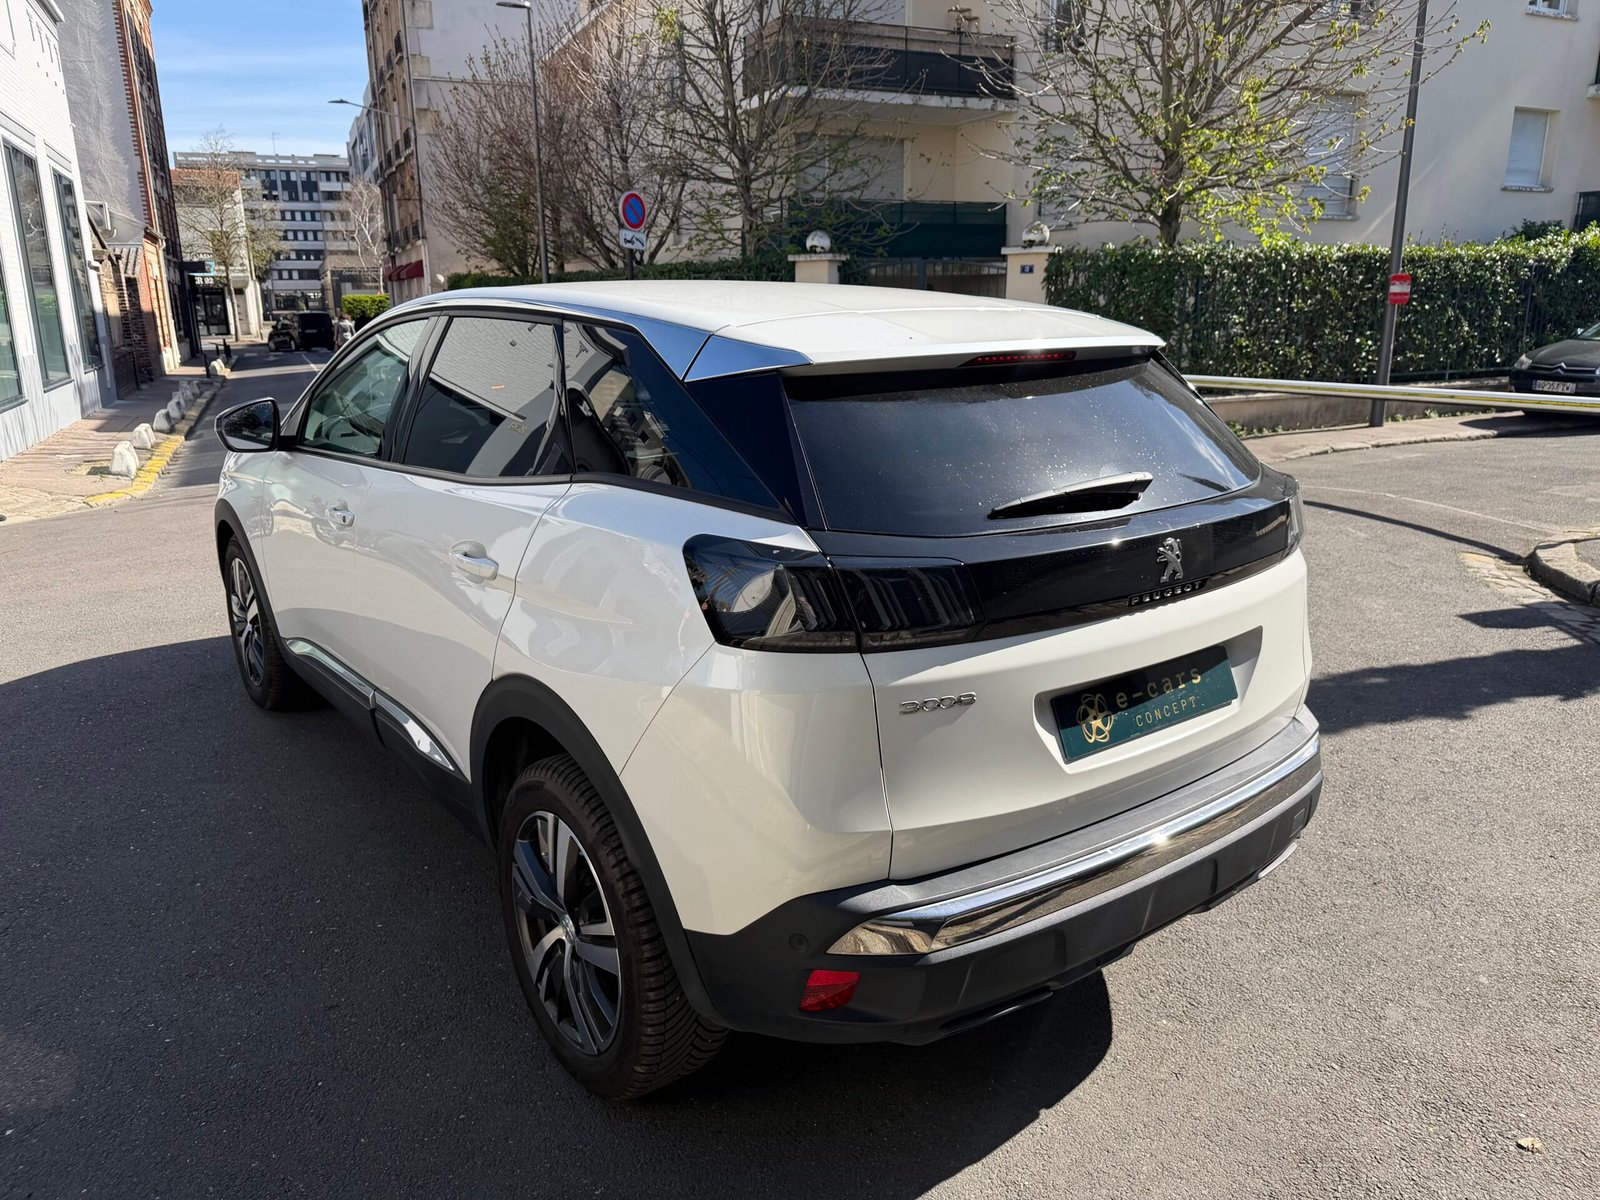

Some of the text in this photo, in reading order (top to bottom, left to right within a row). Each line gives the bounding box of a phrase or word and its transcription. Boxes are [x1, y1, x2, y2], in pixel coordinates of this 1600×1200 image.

[1131, 580, 1202, 605] PEUGEOT
[1116, 667, 1201, 708] e-cars
[899, 691, 977, 715] 3008
[1135, 695, 1197, 727] CONCEPT
